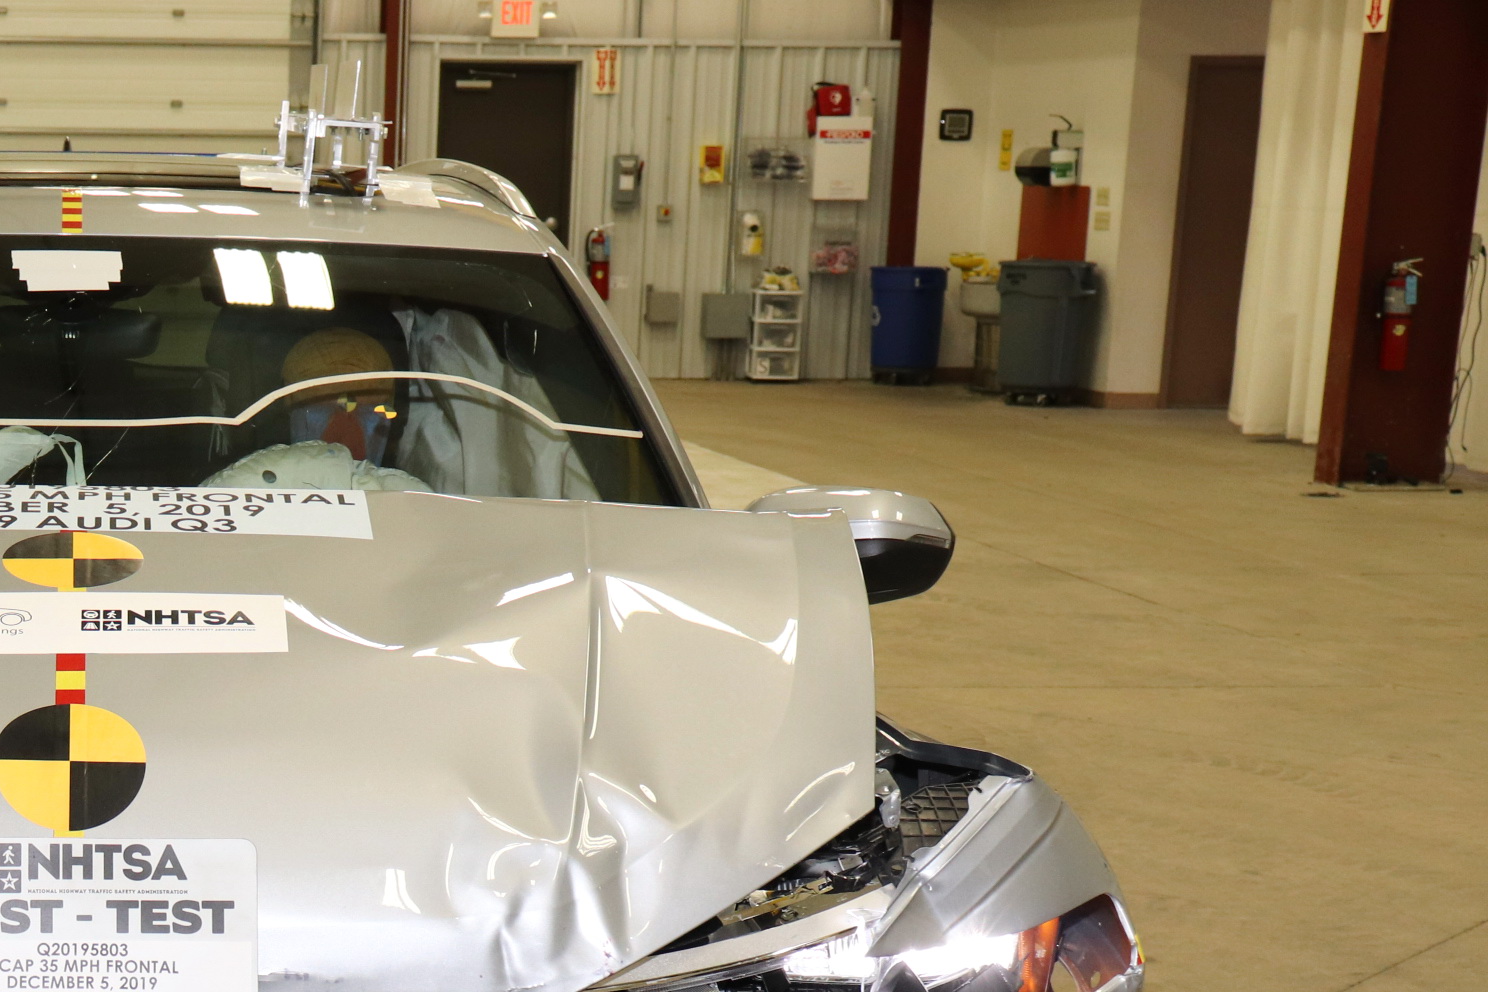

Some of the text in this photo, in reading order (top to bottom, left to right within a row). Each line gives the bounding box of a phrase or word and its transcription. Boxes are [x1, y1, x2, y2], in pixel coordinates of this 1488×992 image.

[501, 0, 534, 25] EXIT
[29, 490, 132, 501] MPH
[152, 492, 356, 506] FRONTAL
[103, 502, 140, 517] 5,
[158, 503, 265, 517] 2019
[35, 515, 152, 531] AUDI
[170, 517, 238, 533] Q3
[127, 609, 255, 626] NHTSA
[28, 843, 188, 881] NHTSA
[106, 899, 235, 935] TEST
[37, 942, 129, 957] Q20195803
[39, 959, 58, 973] 35
[63, 960, 100, 973] MPH
[106, 960, 179, 974] FRONTAL
[7, 975, 157, 991] DECEMBER 5, 2019
